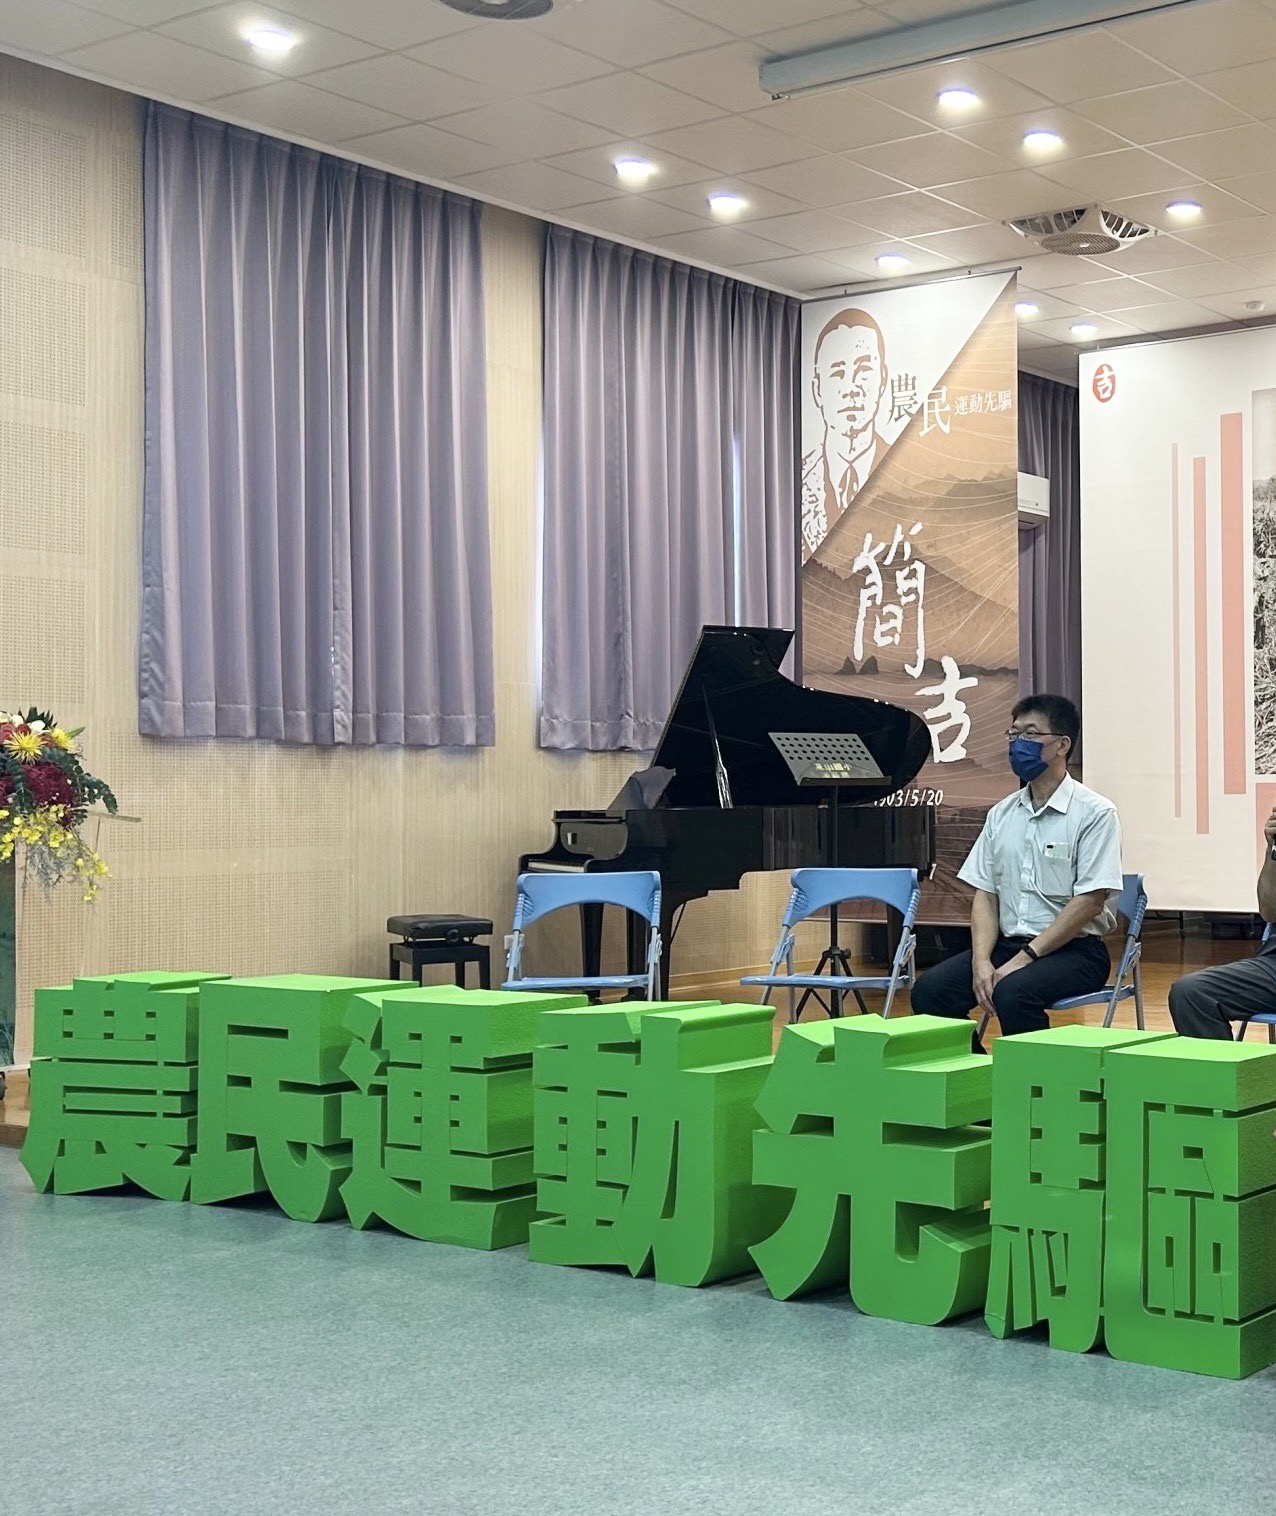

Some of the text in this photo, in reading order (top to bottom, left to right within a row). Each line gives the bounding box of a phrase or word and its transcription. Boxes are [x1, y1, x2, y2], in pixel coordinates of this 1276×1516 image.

[886, 373, 1012, 437] 農民運動先驅
[1094, 365, 1114, 399] 吉
[852, 522, 978, 764] 簡吉
